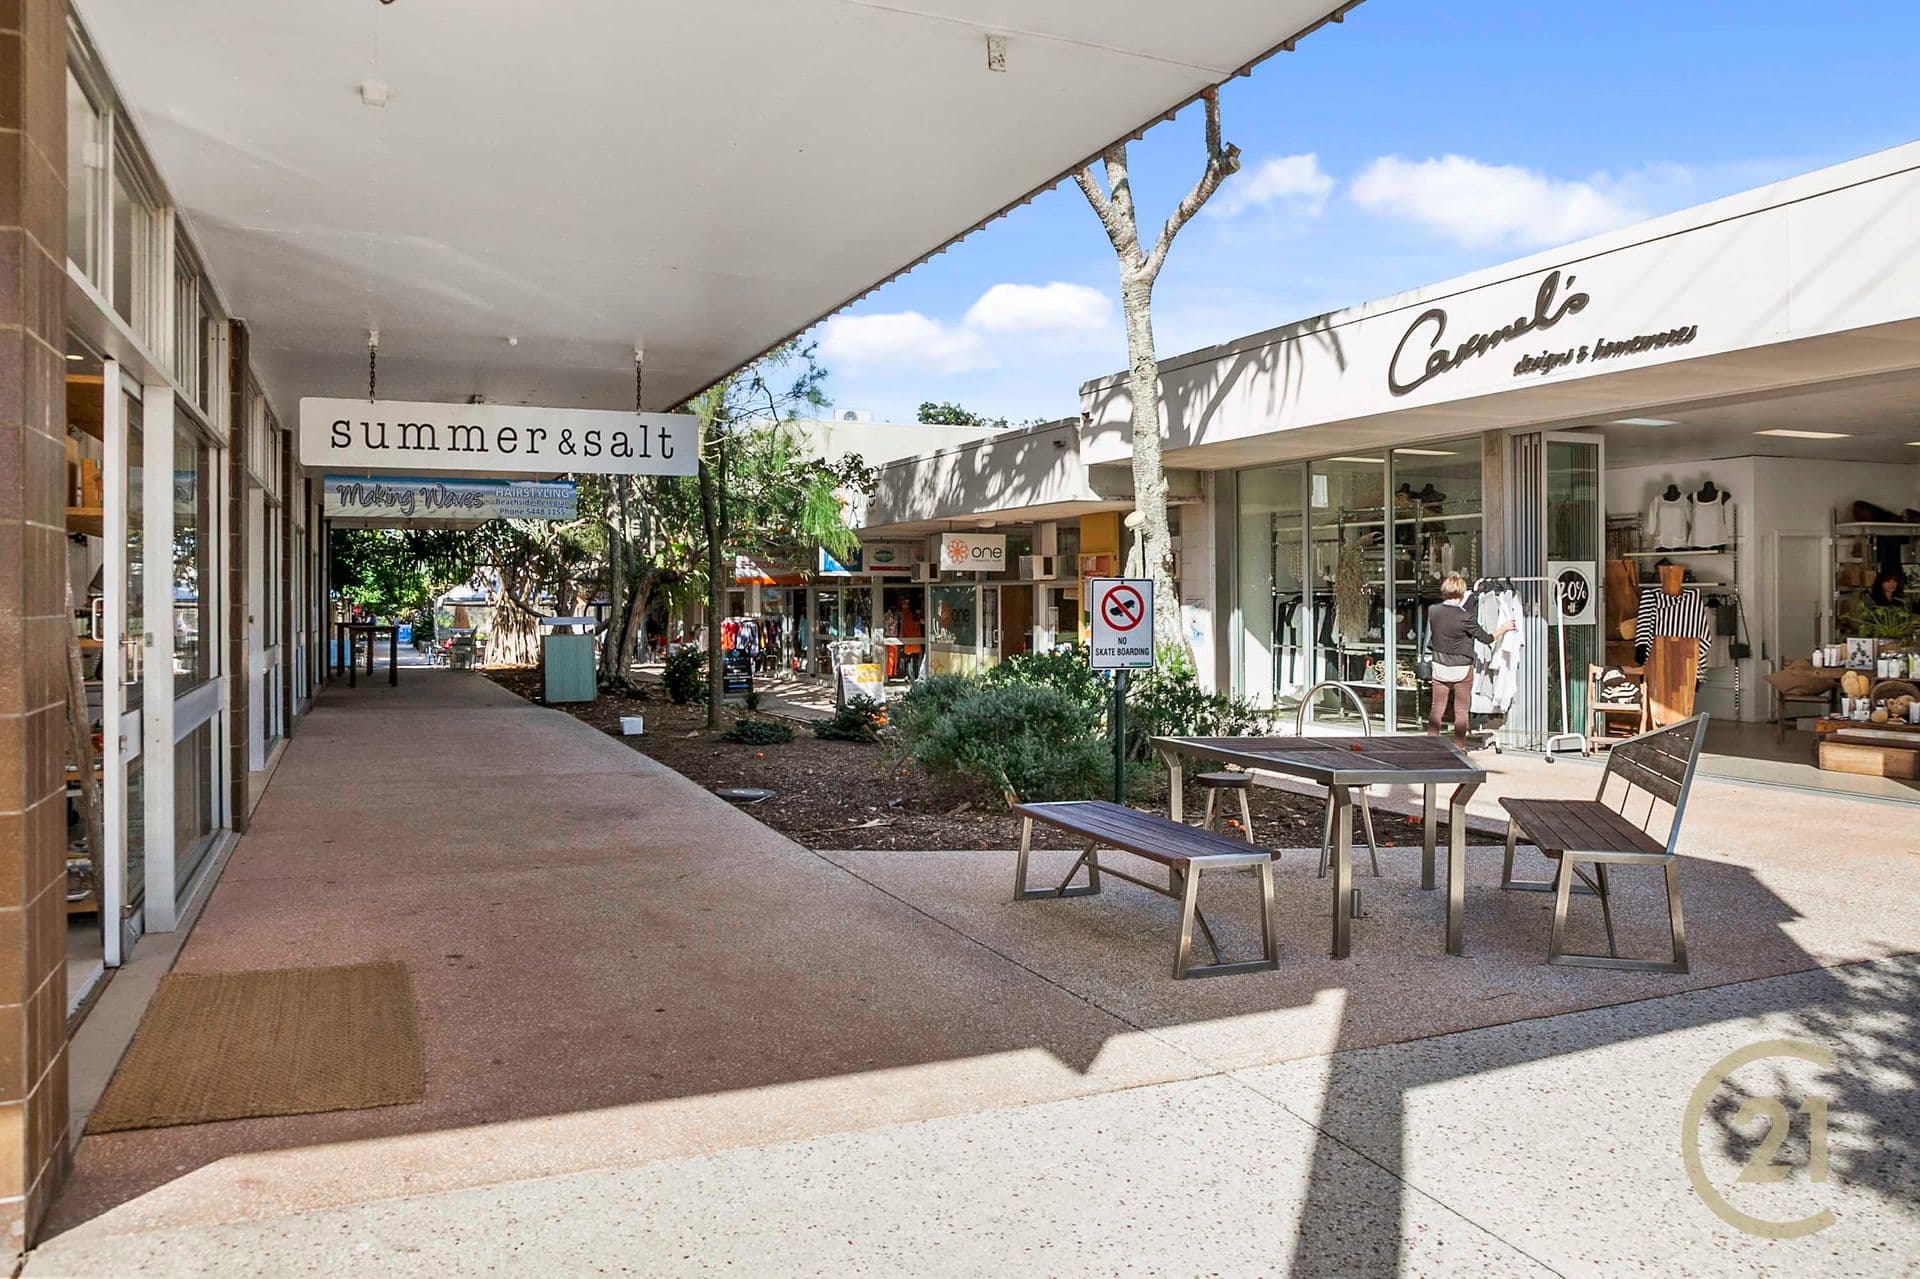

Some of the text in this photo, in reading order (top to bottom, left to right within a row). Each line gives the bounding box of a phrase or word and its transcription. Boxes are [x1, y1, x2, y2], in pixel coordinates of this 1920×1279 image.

[1513, 350, 1575, 376] designs
[495, 487, 570, 498] HAIRSTYLING
[336, 482, 484, 516] Making Waves
[500, 507, 525, 515] Phone
[971, 547, 1002, 559] one
[1117, 637, 1127, 645] NO
[1095, 647, 1150, 656] SKATE BOARDING
